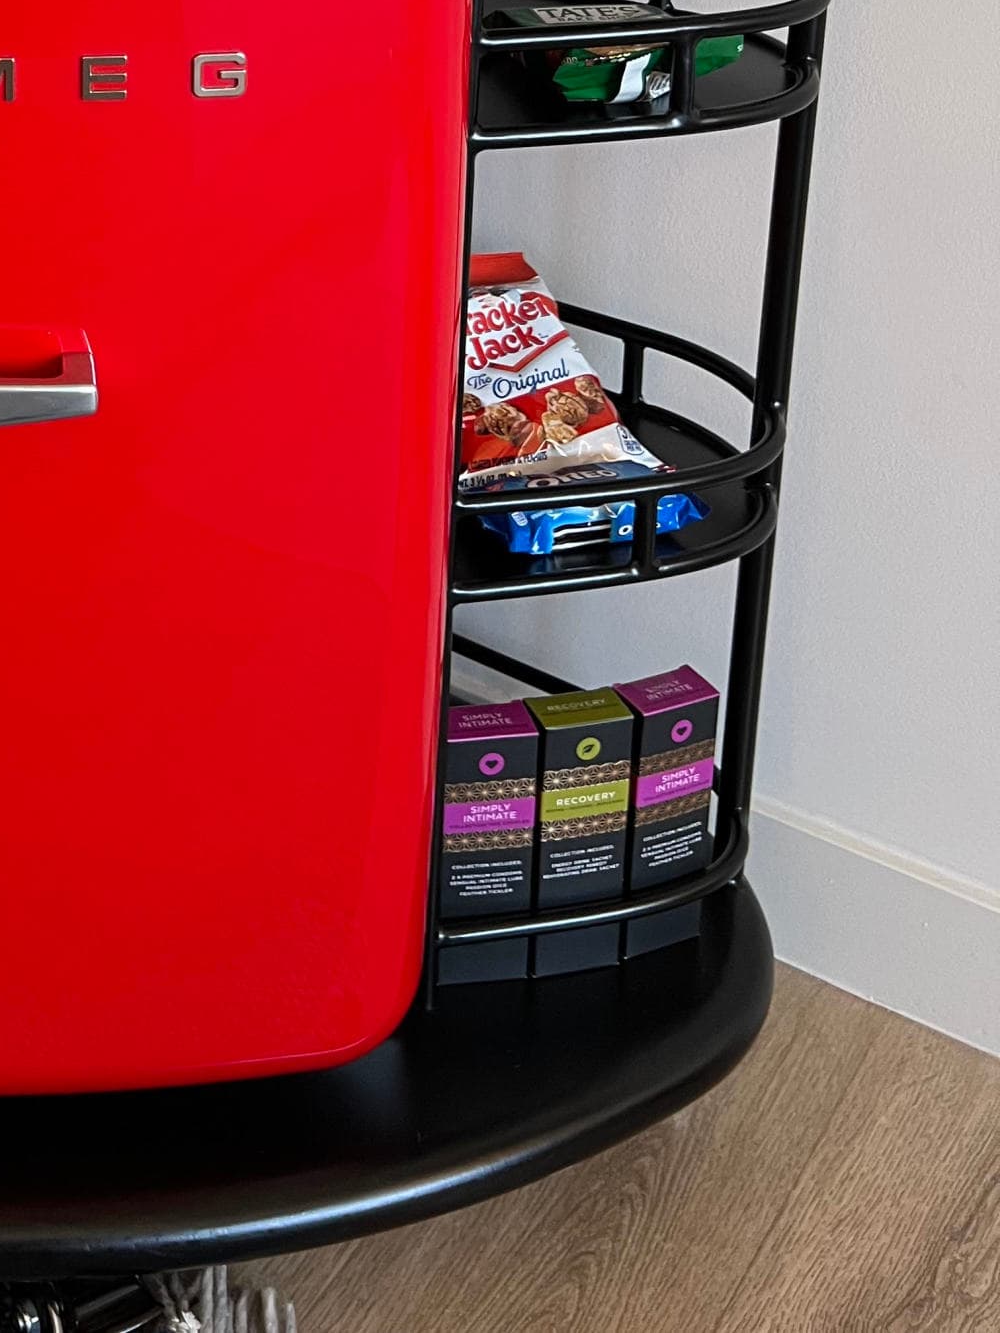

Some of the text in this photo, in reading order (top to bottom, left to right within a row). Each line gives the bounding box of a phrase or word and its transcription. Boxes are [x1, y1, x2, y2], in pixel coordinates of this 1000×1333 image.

[537, 6, 641, 18] TATE'S
[466, 296, 550, 336] racker
[467, 326, 545, 371] Jack
[467, 357, 569, 399] The Original
[527, 467, 618, 489] OREO
[547, 698, 606, 711] RECOVERY
[458, 717, 512, 728] INTIMATE
[462, 712, 502, 721] SIMPLY
[661, 766, 696, 783] SIMPLY
[655, 773, 700, 793] INTIMATE
[556, 791, 616, 806] RECOVERY
[470, 803, 511, 814] SIMPLY
[463, 811, 517, 822] INTIMATE
[643, 830, 675, 842] COLLECTION
[550, 849, 585, 858] COLLECTION
[592, 854, 613, 862] SACHET
[556, 864, 585, 873] RECOVERY
[599, 863, 620, 871] SACHET
